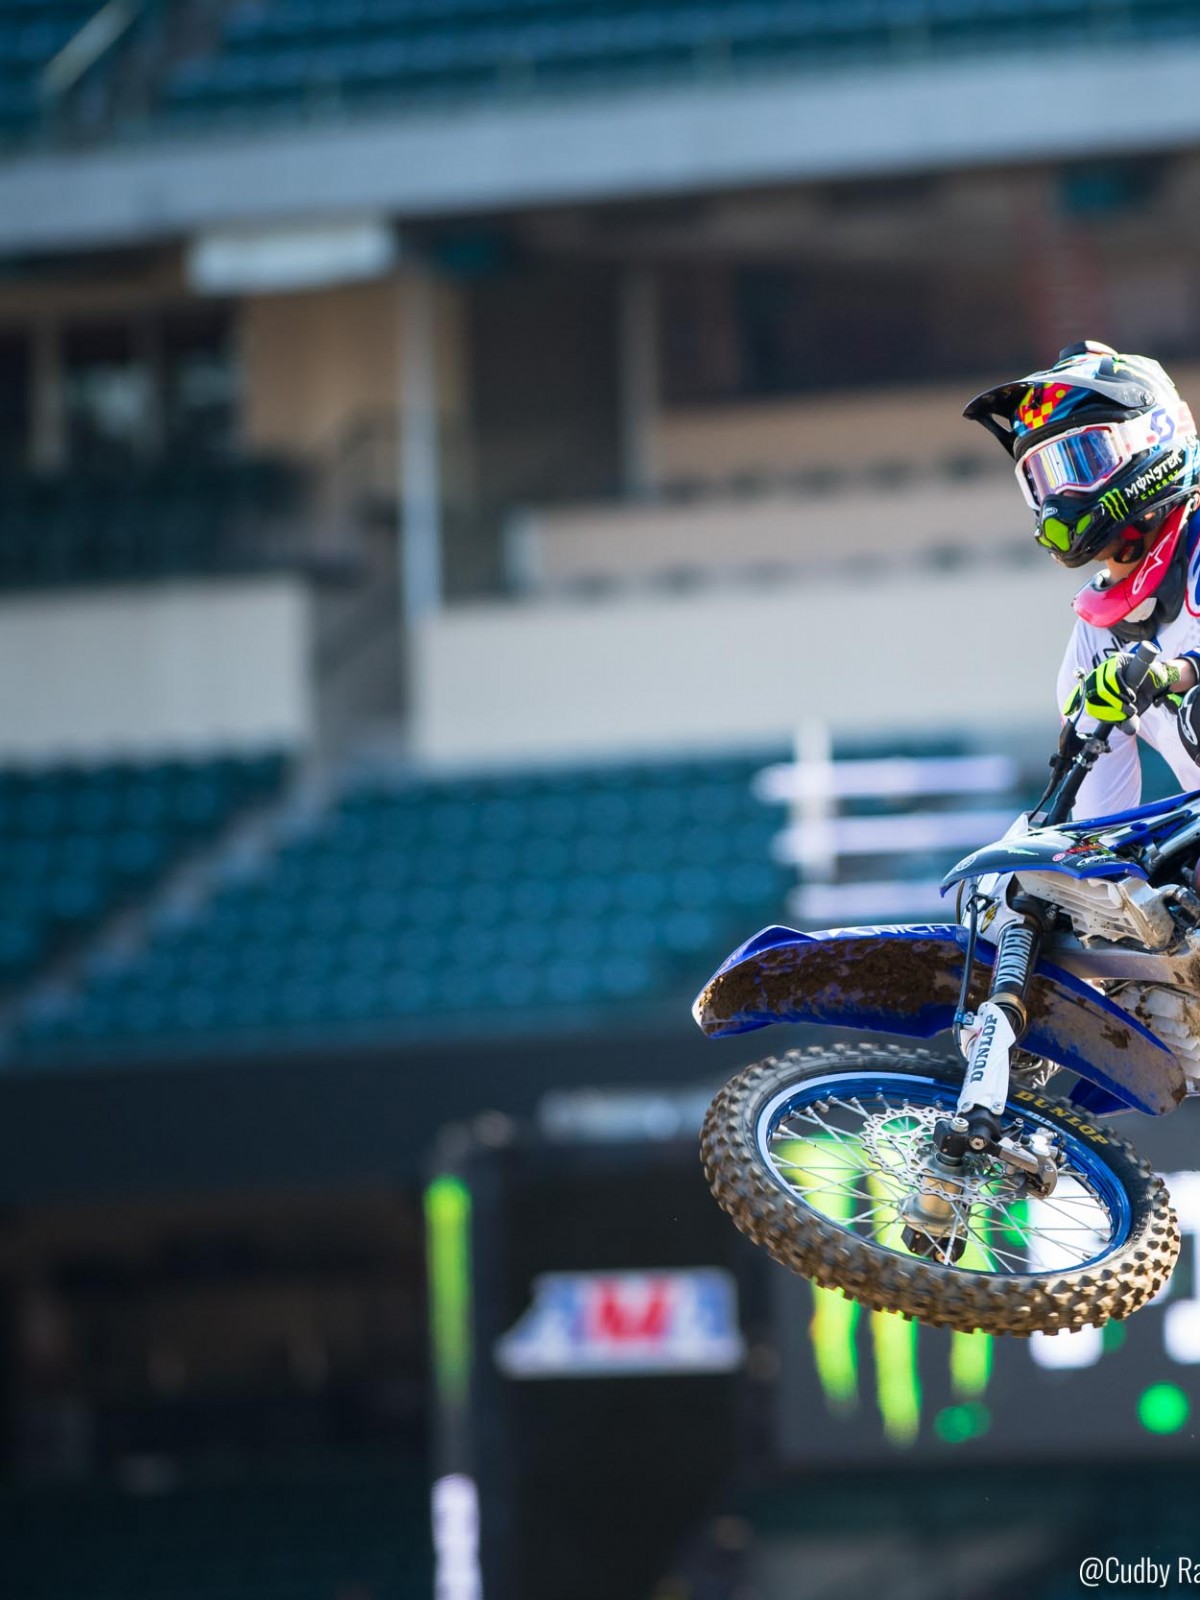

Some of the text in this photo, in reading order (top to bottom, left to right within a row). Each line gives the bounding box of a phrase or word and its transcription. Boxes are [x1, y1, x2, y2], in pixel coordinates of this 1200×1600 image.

[1124, 444, 1183, 498] MONSTER
[995, 926, 1034, 988] YAMAHA
[970, 1013, 998, 1083] DUNLOP
[1014, 1090, 1110, 1145] DUNLOP
